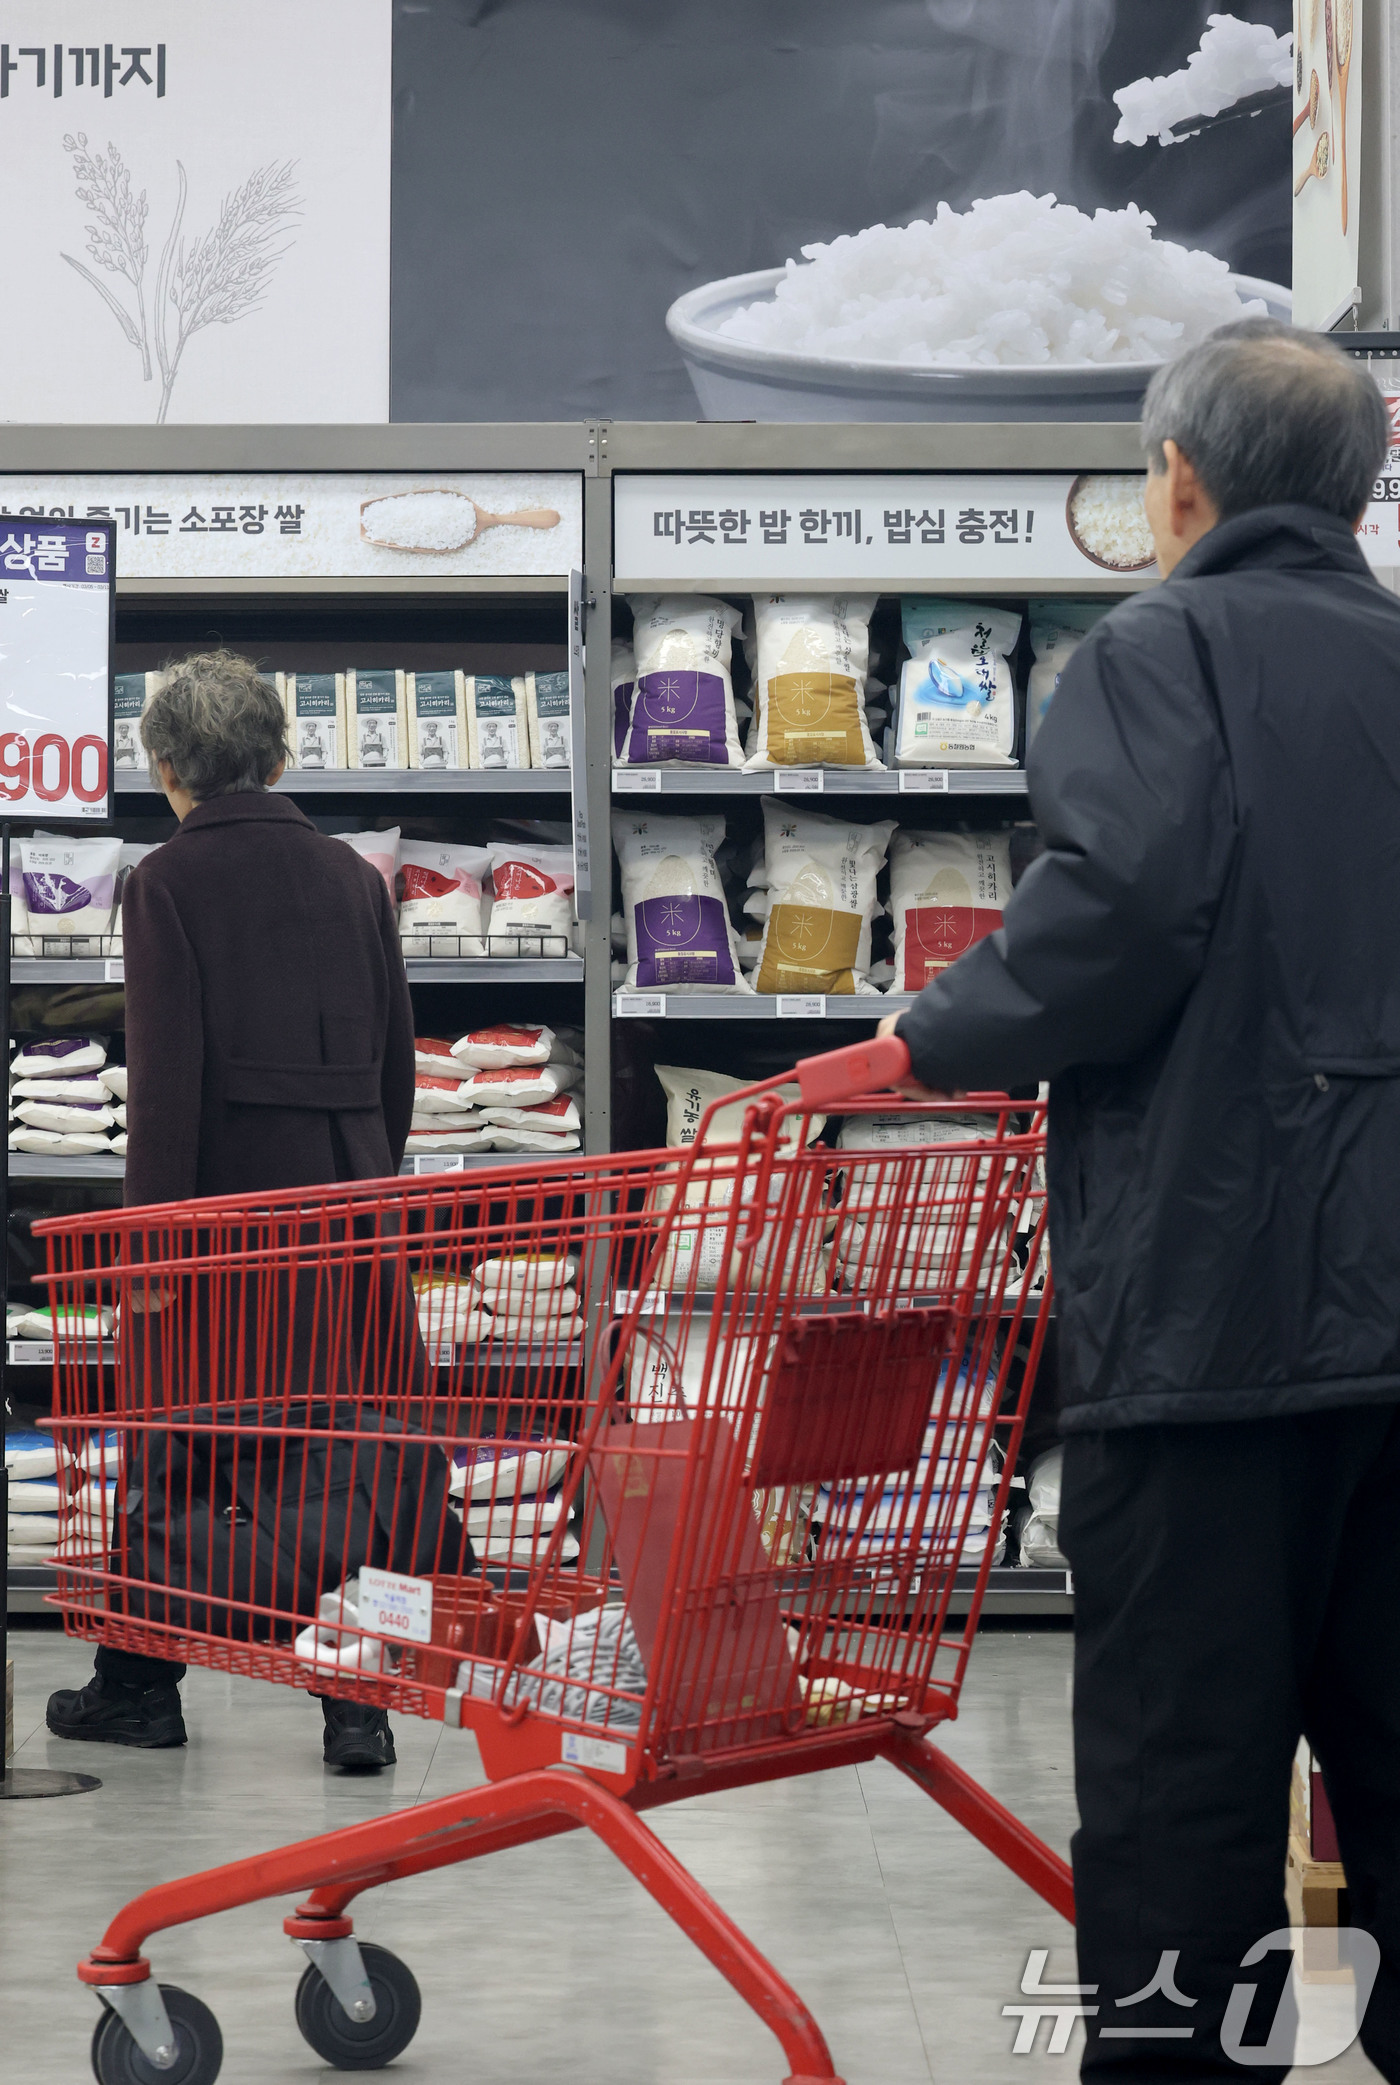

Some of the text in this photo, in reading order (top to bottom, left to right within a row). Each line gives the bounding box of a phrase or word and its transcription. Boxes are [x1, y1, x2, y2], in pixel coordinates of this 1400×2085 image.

[178, 504, 269, 535] 소포장
[273, 504, 306, 535] 쌀
[652, 509, 1035, 546] 따뜻한 밥 한끼, 밥심 충전!
[1354, 523, 1380, 536] 시각
[0, 533, 70, 572] 상품
[667, 705, 676, 714] kg
[0, 732, 108, 803] 900
[986, 854, 997, 901] 고시히카리
[399, 1582, 421, 1596] Mart
[378, 1610, 410, 1630] 0440
